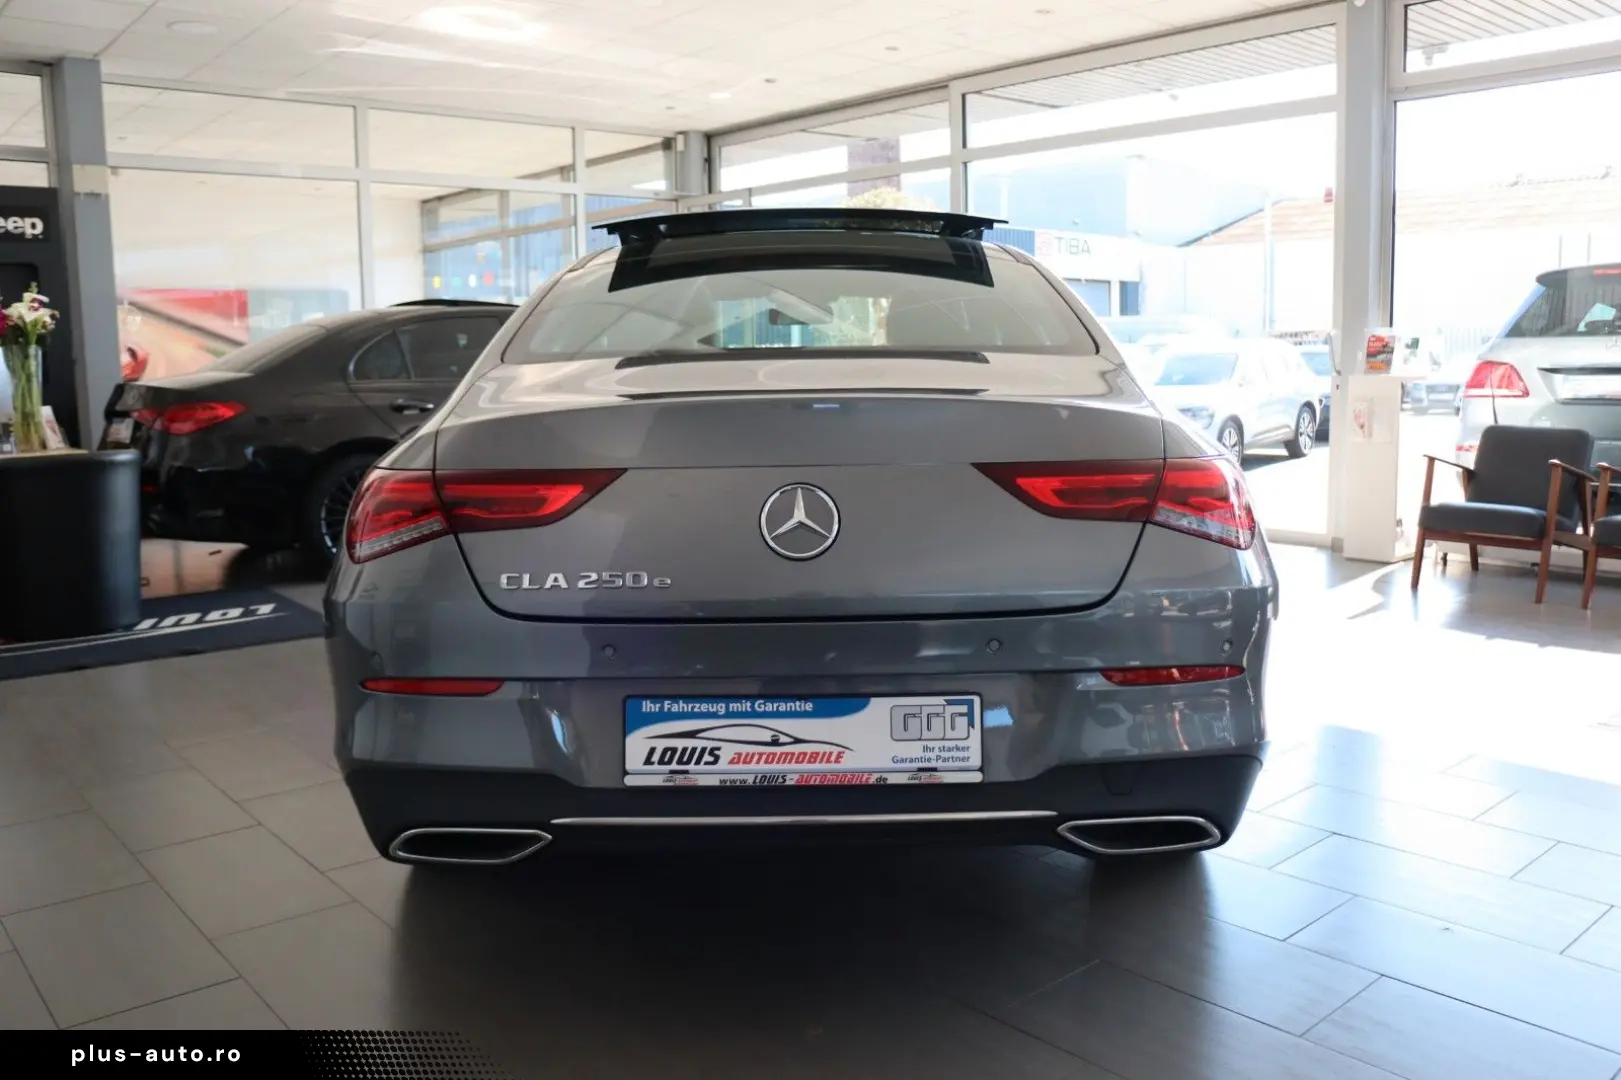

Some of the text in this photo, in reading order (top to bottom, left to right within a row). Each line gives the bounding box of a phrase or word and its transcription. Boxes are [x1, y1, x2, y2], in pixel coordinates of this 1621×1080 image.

[1054, 236, 1092, 256] TIBA
[500, 572, 569, 589] CLA
[132, 602, 277, 631] LOUI
[642, 700, 813, 715] Ihr Fahrzeug mit Garantie
[642, 746, 722, 766] LOUIS
[922, 744, 970, 753] Ihr starker
[892, 755, 971, 764] Garantie-Partner
